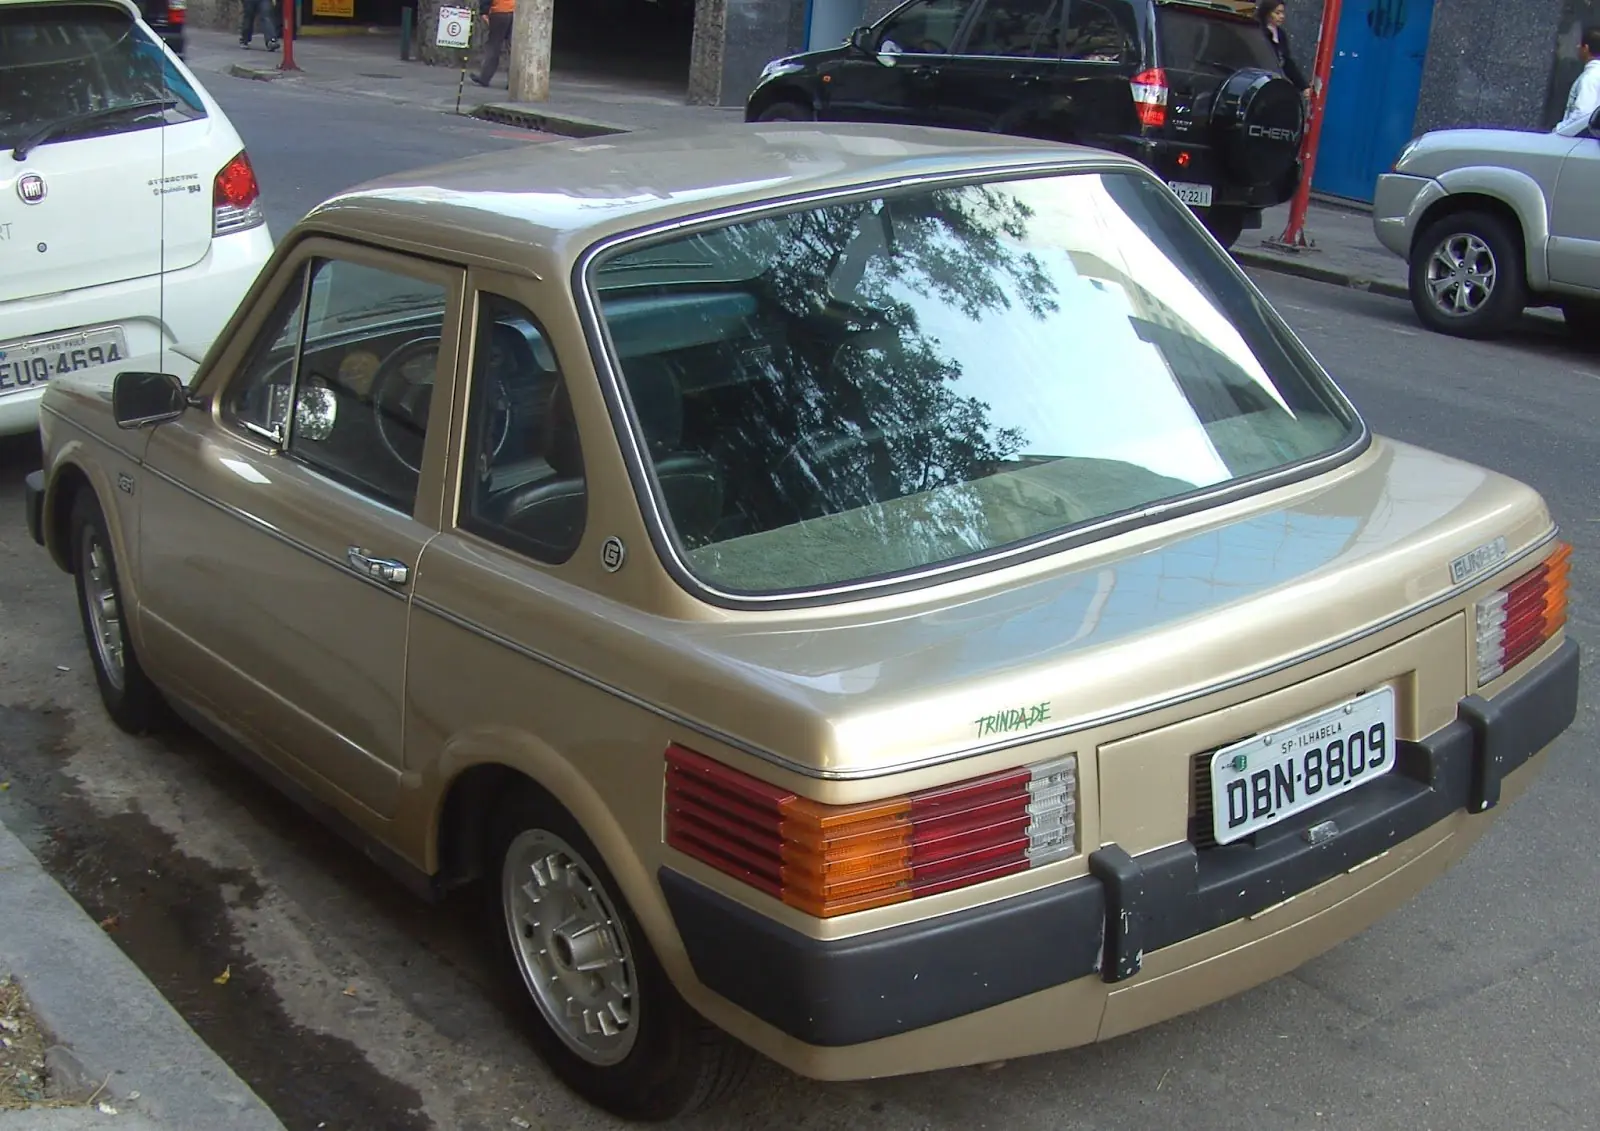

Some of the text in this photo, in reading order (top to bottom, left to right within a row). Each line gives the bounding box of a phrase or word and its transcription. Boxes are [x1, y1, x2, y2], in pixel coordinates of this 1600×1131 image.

[1249, 125, 1299, 142] CHERY
[22, 181, 42, 197] FIAT
[974, 701, 1052, 739] TRINDADE
